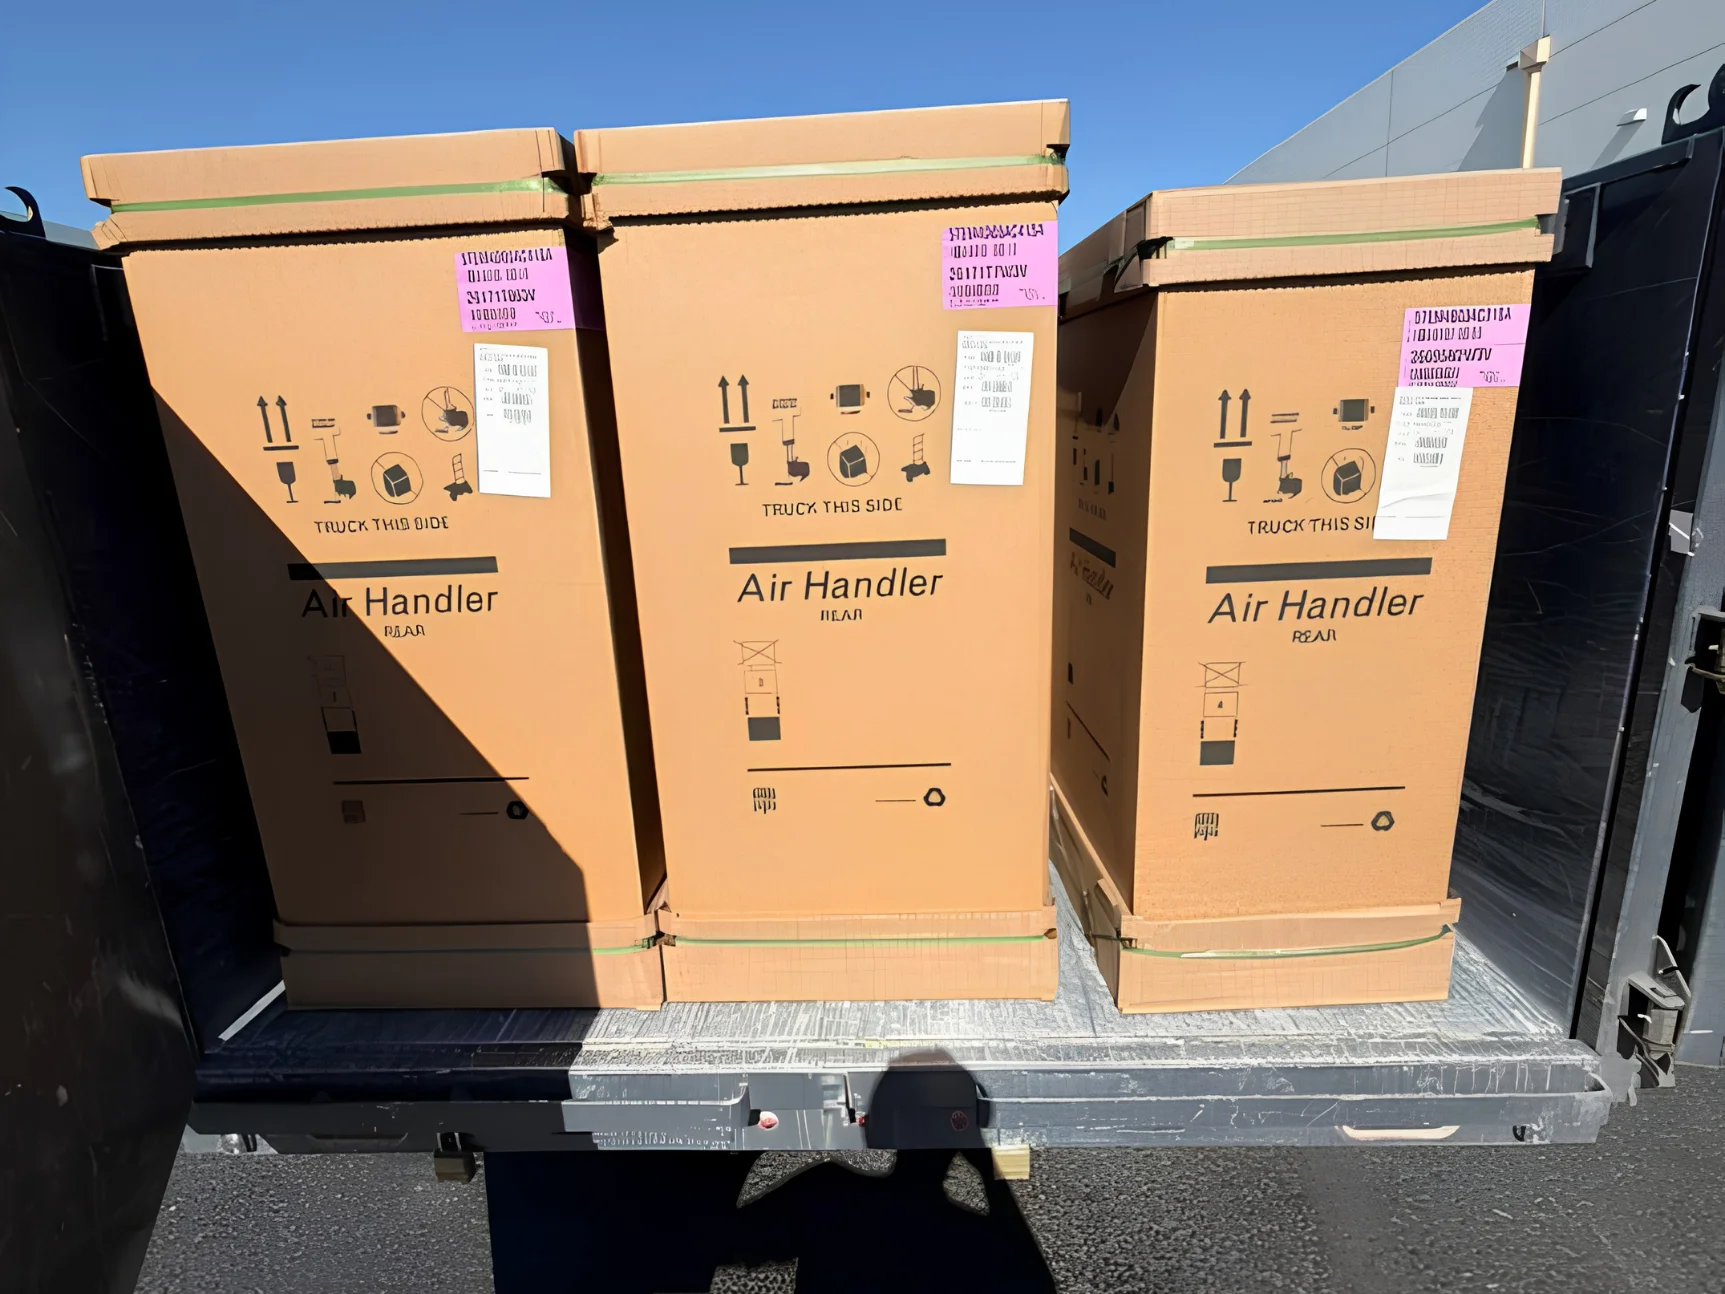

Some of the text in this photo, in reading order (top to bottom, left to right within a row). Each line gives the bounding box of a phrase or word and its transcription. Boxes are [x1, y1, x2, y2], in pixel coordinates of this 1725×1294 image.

[761, 497, 902, 517] TRUCK THIS SIDE
[1248, 516, 1376, 535] TRUCK THIS SI
[302, 585, 499, 618] Air Handler
[737, 567, 944, 603] Air Handler
[1207, 586, 1424, 624] Air Handler
